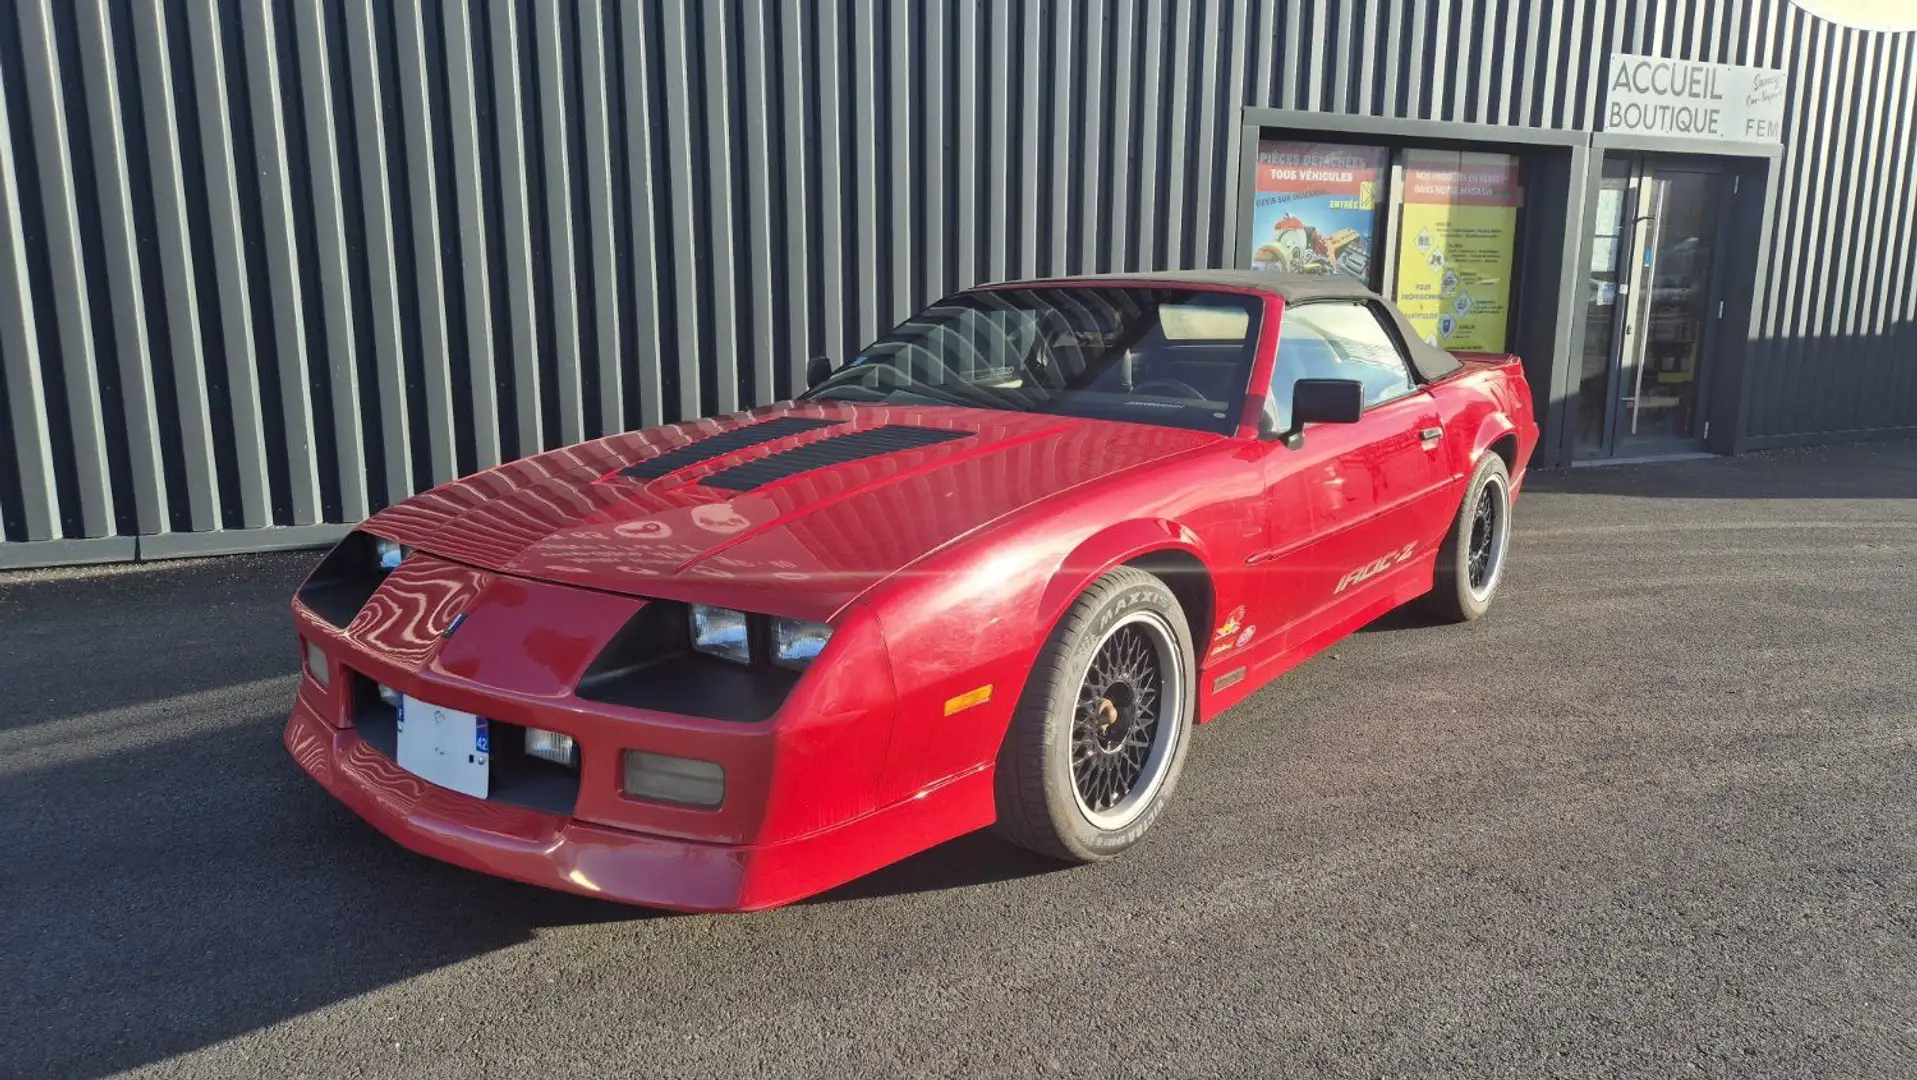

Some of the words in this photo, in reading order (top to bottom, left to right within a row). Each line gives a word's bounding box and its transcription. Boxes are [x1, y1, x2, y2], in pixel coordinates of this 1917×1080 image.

[1612, 60, 1723, 100] ACCUEIL
[1609, 102, 1720, 134] BOUTIQUE
[1745, 118, 1779, 137] FEM
[1271, 168, 1297, 180] TOUS
[1299, 168, 1353, 182] VÉHICULES
[1100, 591, 1168, 629] MAXXIS
[476, 735, 488, 751] 42
